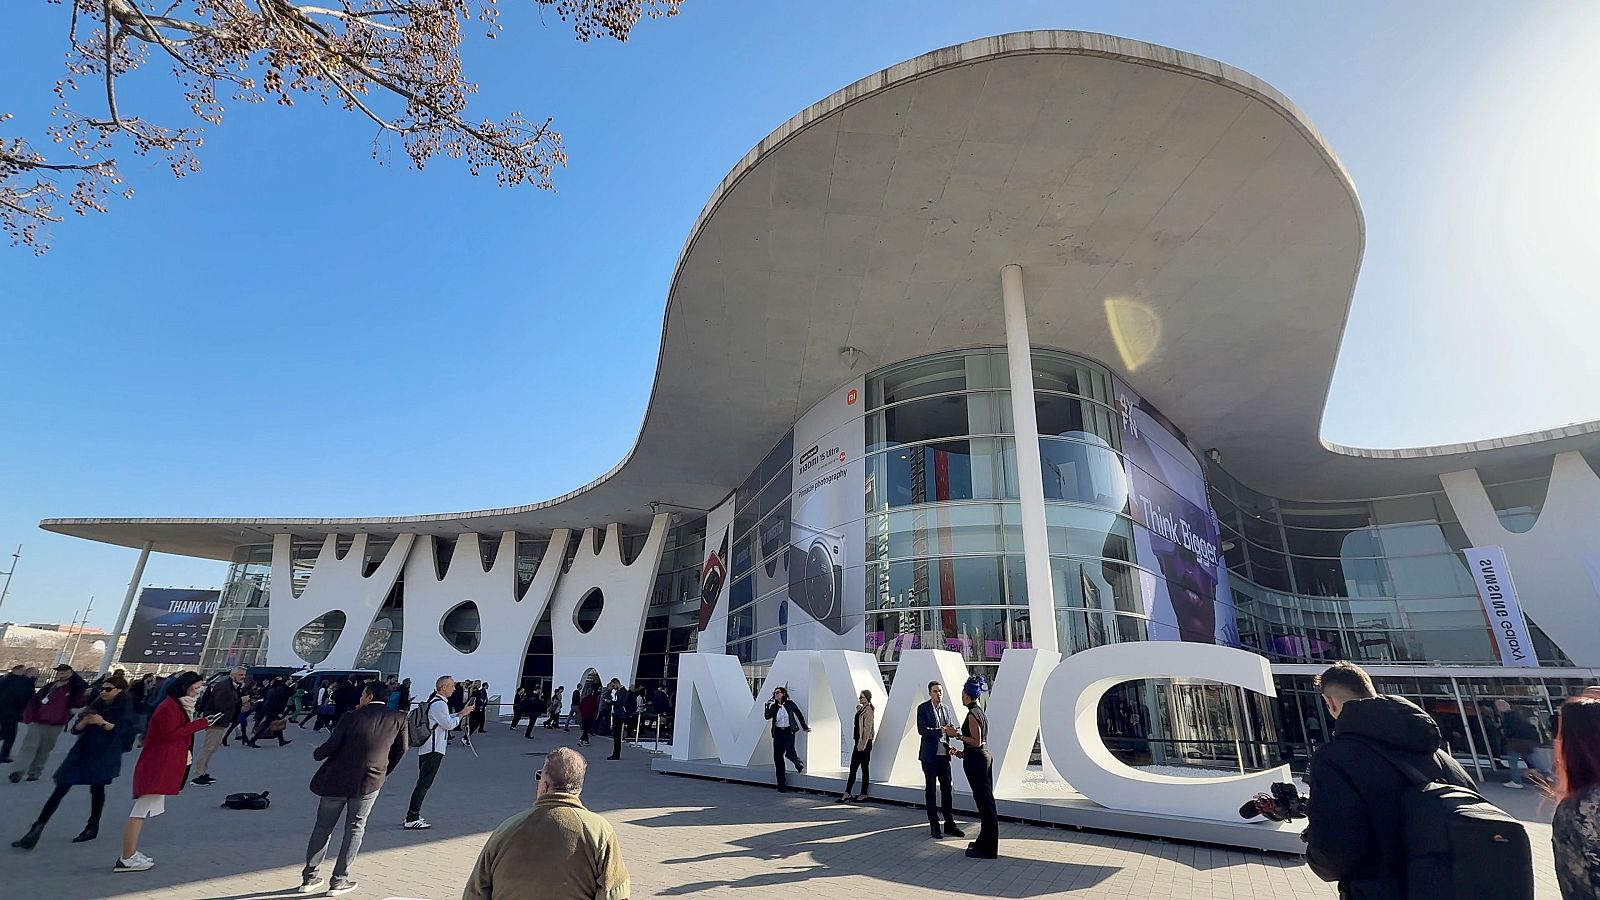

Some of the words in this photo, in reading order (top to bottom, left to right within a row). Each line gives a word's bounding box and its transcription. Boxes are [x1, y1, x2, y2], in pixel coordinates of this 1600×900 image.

[826, 446, 840, 459] Ultra
[798, 483, 815, 498] Pinnacle
[814, 468, 848, 491] photography
[1139, 494, 1182, 546] Think
[1179, 518, 1219, 567] Bigger
[168, 600, 201, 614] THANK
[204, 601, 217, 614] YO
[671, 642, 1291, 823] MWC
